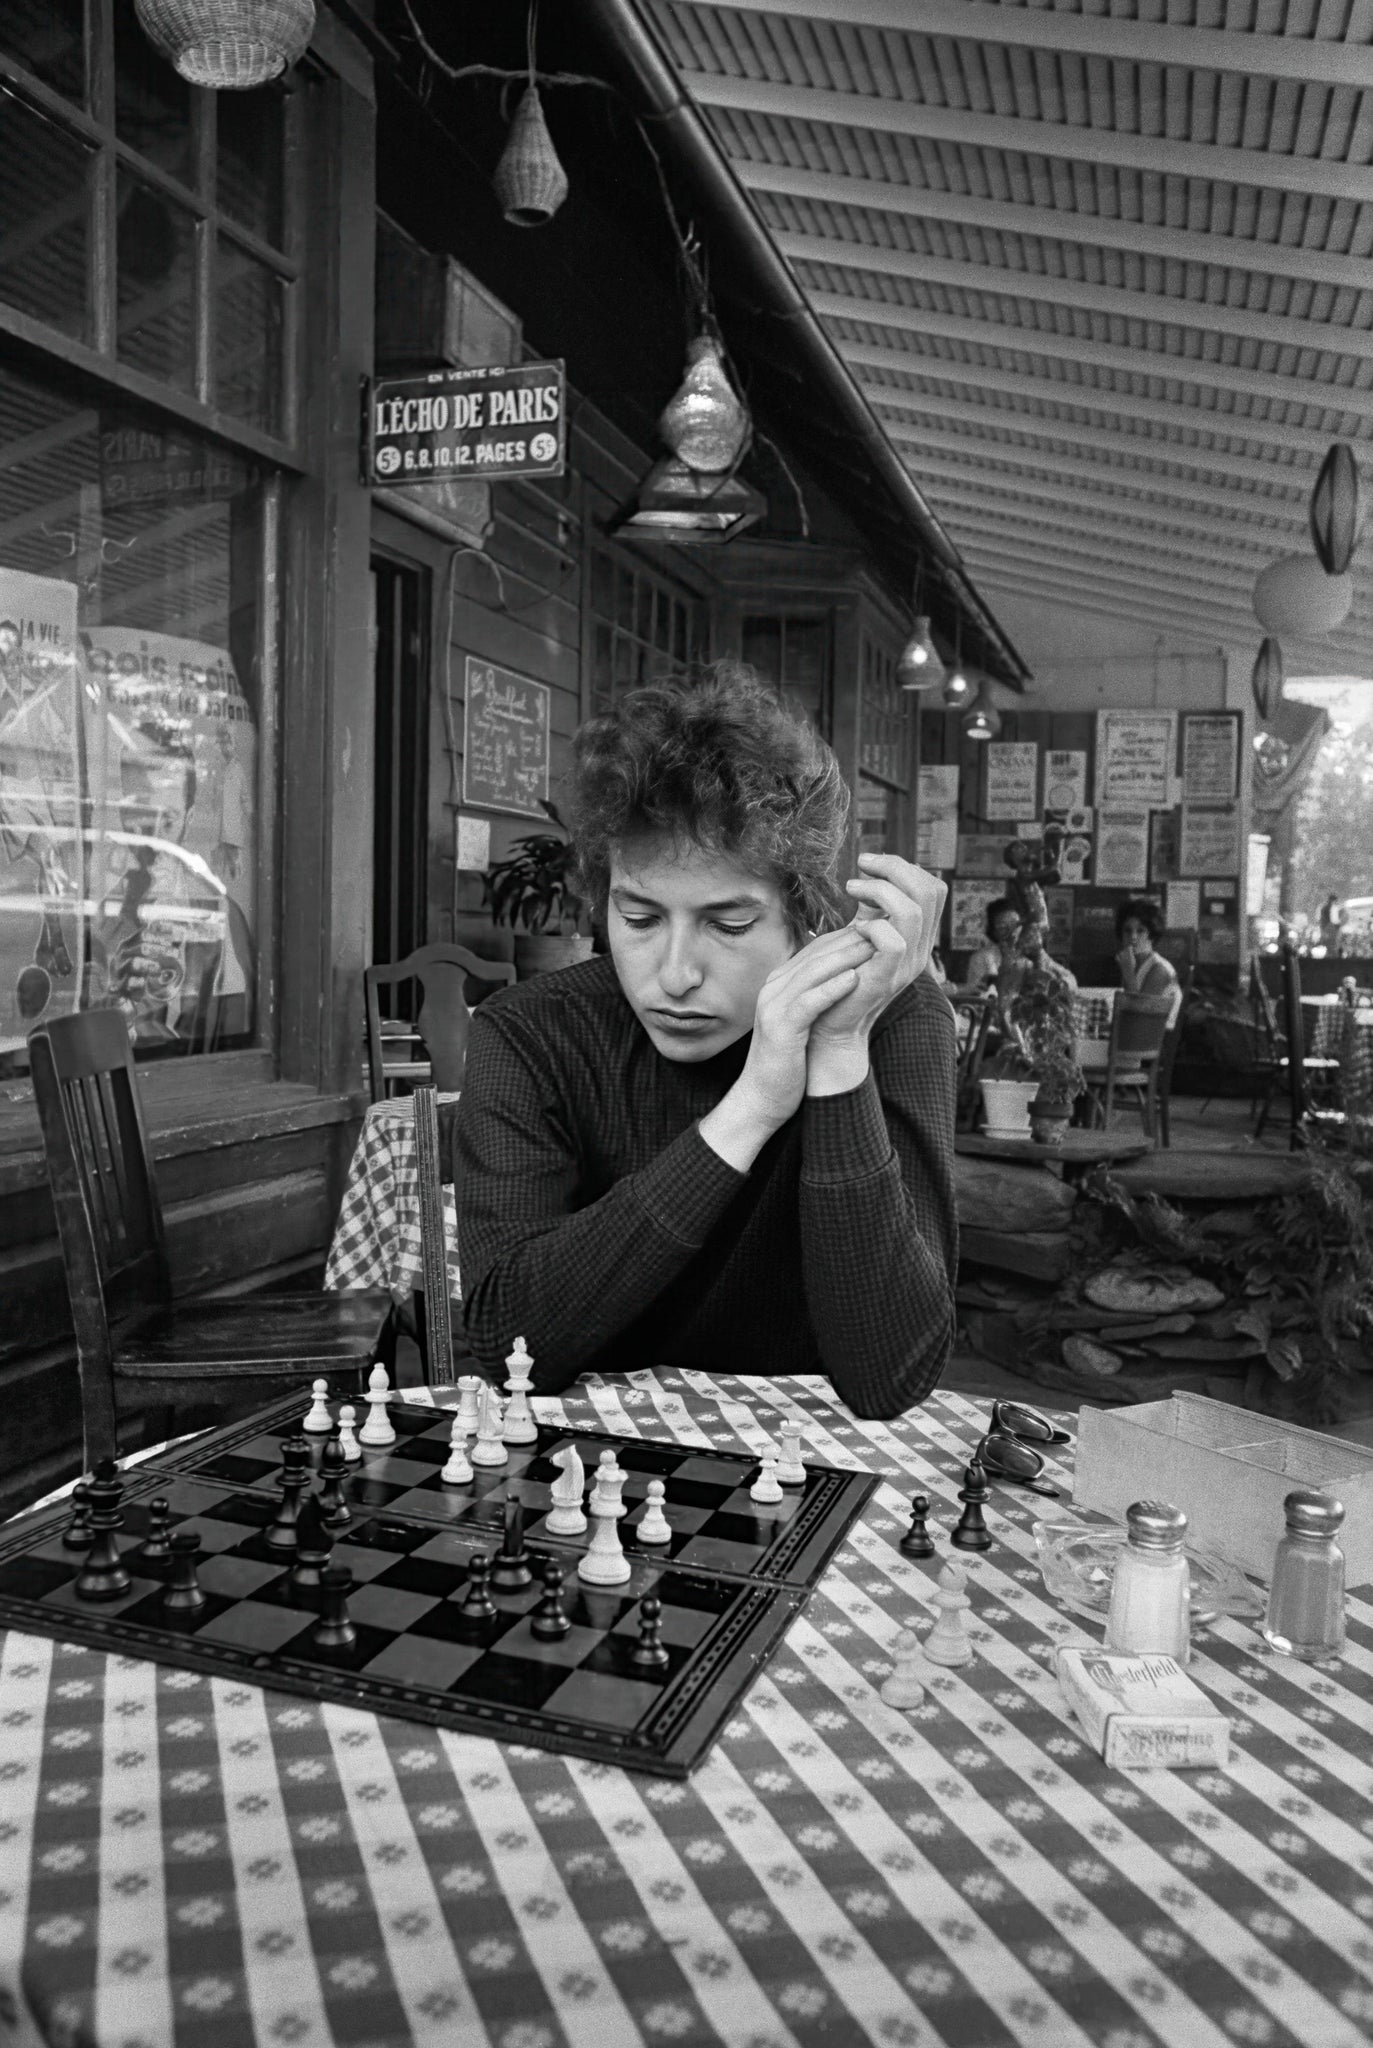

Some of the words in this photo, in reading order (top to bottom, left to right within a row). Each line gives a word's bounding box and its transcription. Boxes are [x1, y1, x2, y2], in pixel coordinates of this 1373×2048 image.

[448, 368, 486, 380] VENTE
[453, 393, 484, 429] DE
[488, 386, 559, 426] PARIS
